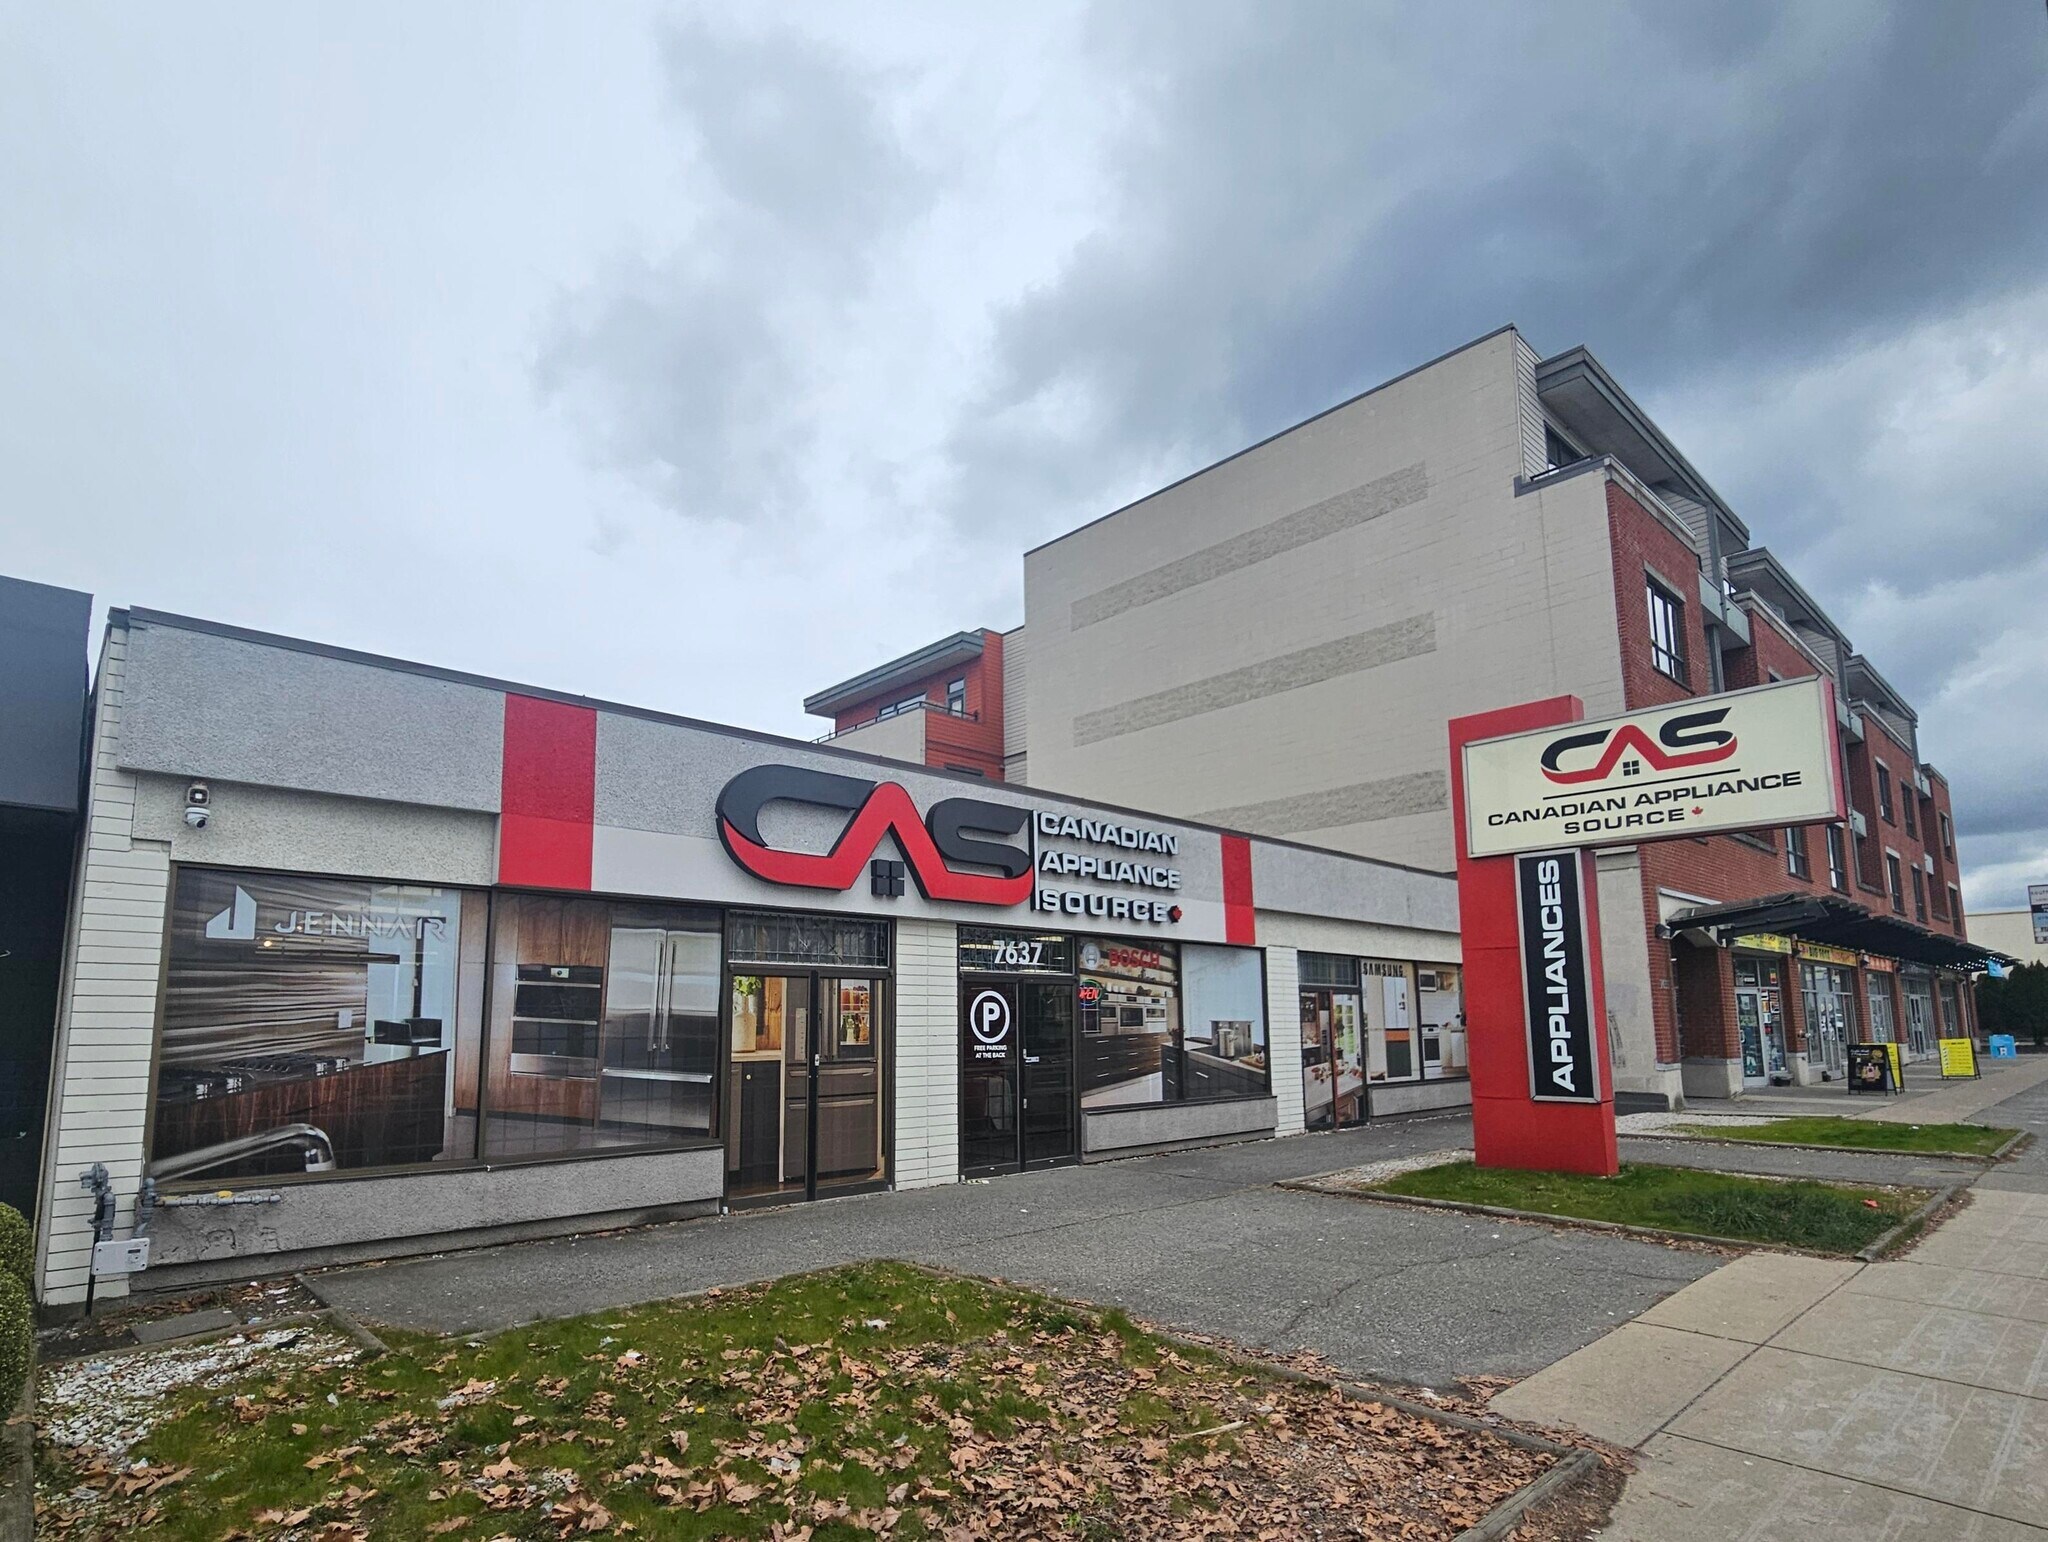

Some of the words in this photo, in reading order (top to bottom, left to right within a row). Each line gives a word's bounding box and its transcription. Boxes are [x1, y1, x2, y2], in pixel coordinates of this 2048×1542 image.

[1540, 706, 1738, 785] CAS
[1487, 796, 1626, 827] CANADIAN
[1633, 771, 1802, 808] APPLIANCE
[715, 764, 1035, 906] CAS
[1039, 811, 1179, 855] CANADIAN
[1564, 808, 1685, 834] SOURCE
[1041, 850, 1182, 890] APPLIANCE
[1042, 889, 1168, 923] SOURCE
[274, 910, 448, 943] JENNAIR
[992, 939, 1043, 966] 7637
[1108, 948, 1160, 969] BOSCH
[1362, 962, 1404, 978] SAMSUNG
[1537, 859, 1576, 1093] APPLIANCES
[983, 1001, 1001, 1032] P
[973, 1044, 986, 1052] FREE
[986, 1044, 1008, 1052] PARKING
